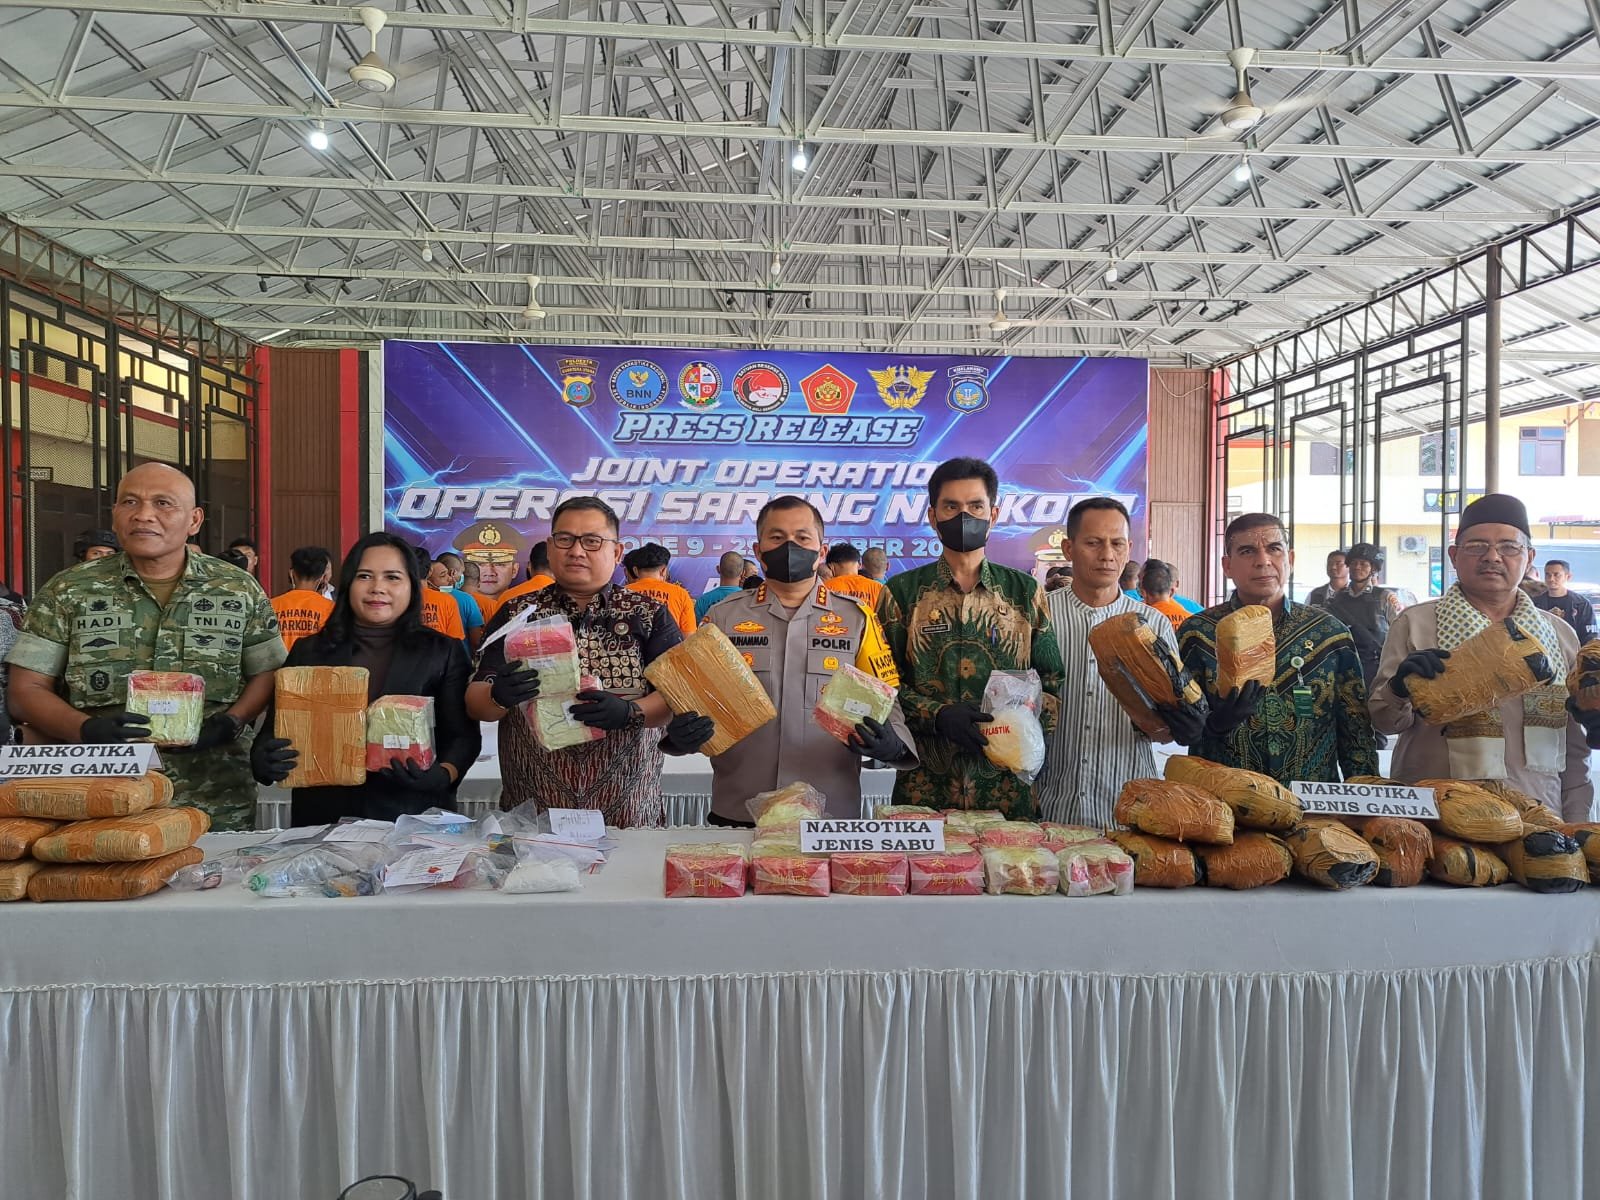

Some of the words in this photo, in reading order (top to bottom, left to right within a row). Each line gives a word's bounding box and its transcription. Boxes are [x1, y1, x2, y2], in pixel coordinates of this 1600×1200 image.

[626, 389, 652, 399] BNN
[614, 412, 747, 444] PRESS
[746, 415, 925, 447] RELEASE
[571, 457, 709, 486] JOINT
[714, 460, 932, 488] OPERATIO
[397, 487, 650, 521] OPERSI
[656, 490, 880, 524] SARNG
[687, 536, 705, 556] 9
[911, 537, 943, 557] 20
[275, 608, 321, 621] TAHANAN
[77, 616, 122, 629] HADI
[194, 616, 218, 626] TNI
[224, 619, 241, 630] AD
[812, 638, 851, 650] POLRI
[8, 745, 137, 758] NARKOTIKA
[0, 763, 63, 775] JENIS
[70, 762, 141, 775] GANJA
[1300, 783, 1420, 800] NARKOTIKA
[1300, 800, 1360, 813] JENIS
[1366, 803, 1434, 817] GANJA
[806, 821, 932, 833] NARKOTIKA
[811, 839, 874, 851] JENIS
[881, 839, 936, 851] SABU
